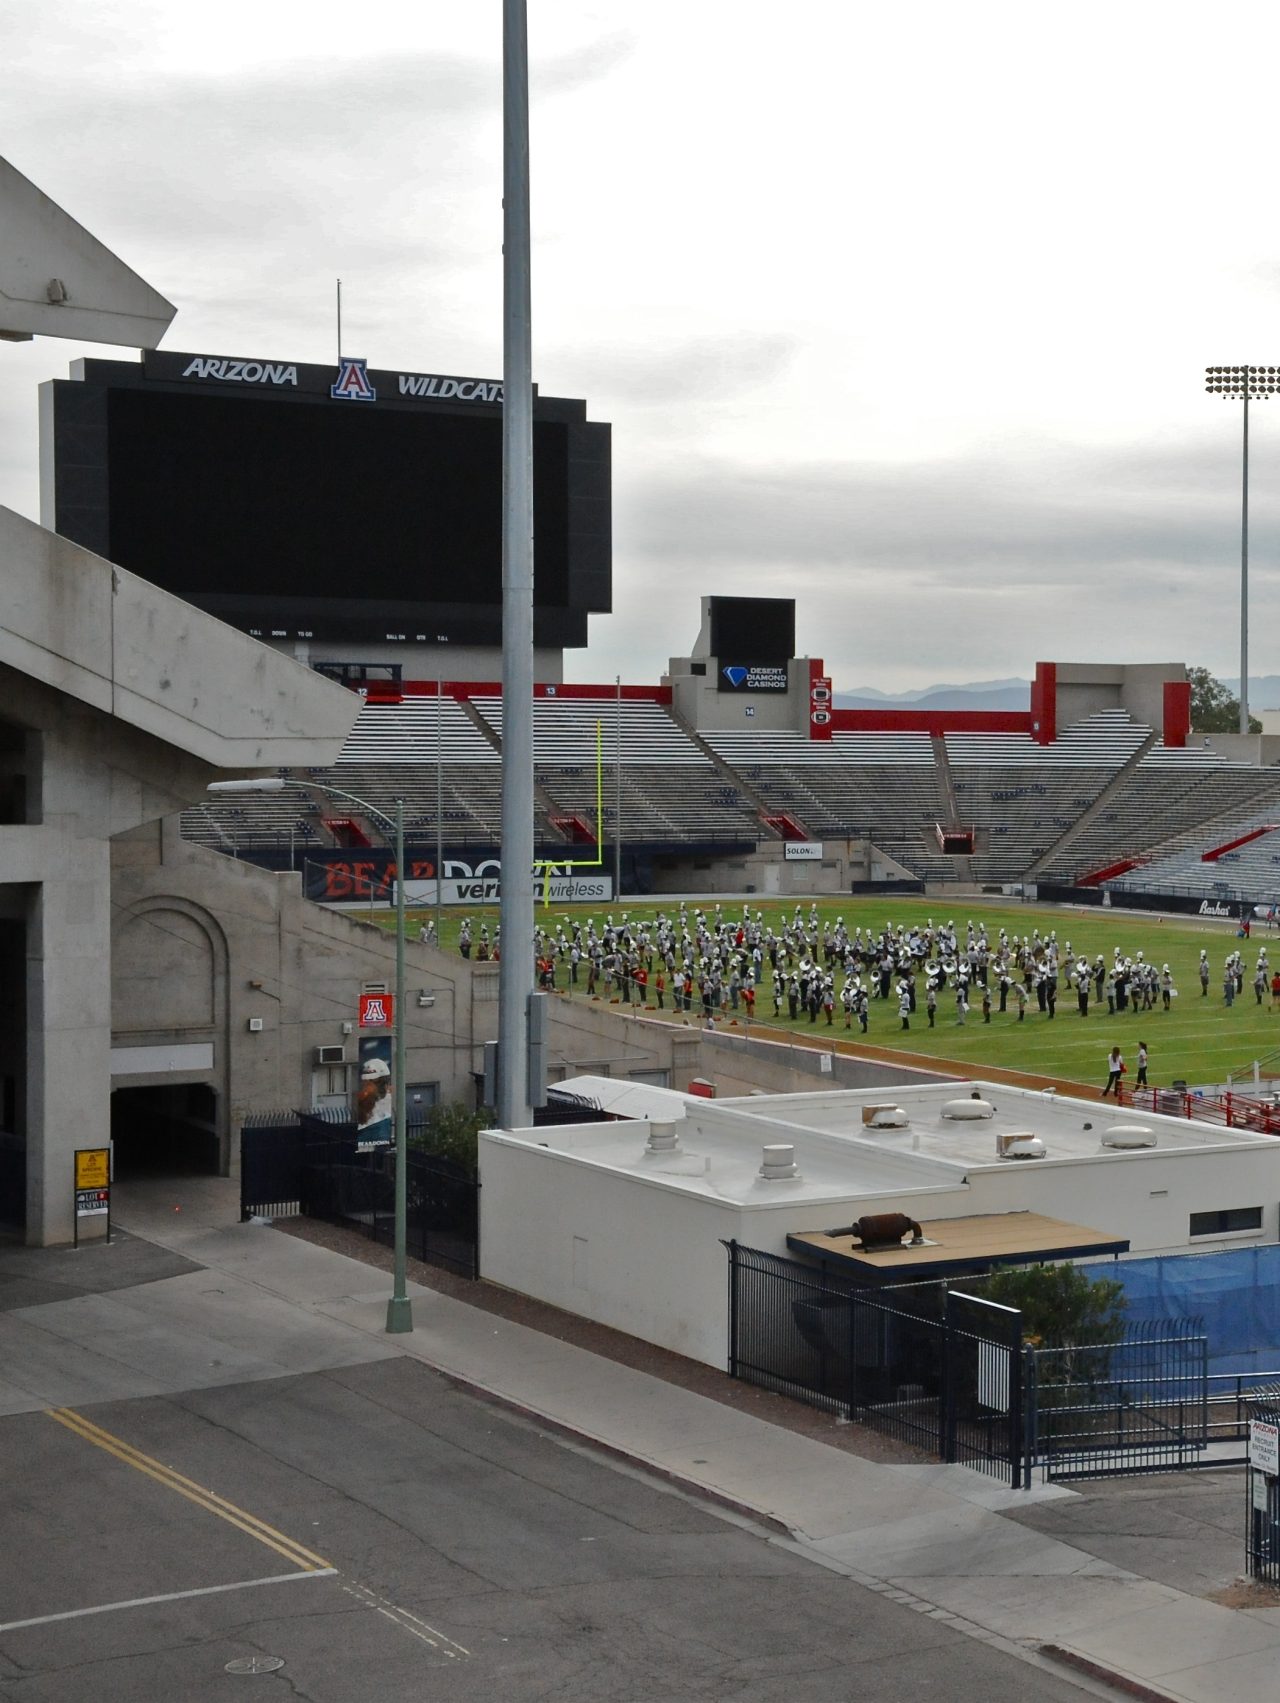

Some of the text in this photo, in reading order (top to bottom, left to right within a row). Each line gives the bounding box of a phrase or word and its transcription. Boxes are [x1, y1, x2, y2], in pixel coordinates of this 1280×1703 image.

[183, 357, 298, 386] ARIZONA
[750, 667, 783, 675] DESERT
[747, 674, 787, 682] DIAMOND
[357, 687, 368, 697] 12
[546, 687, 556, 695] 13
[547, 881, 605, 898] wireless
[1253, 1422, 1277, 1435] ARIZONA
[1252, 1443, 1277, 1456] ENTRANCE
